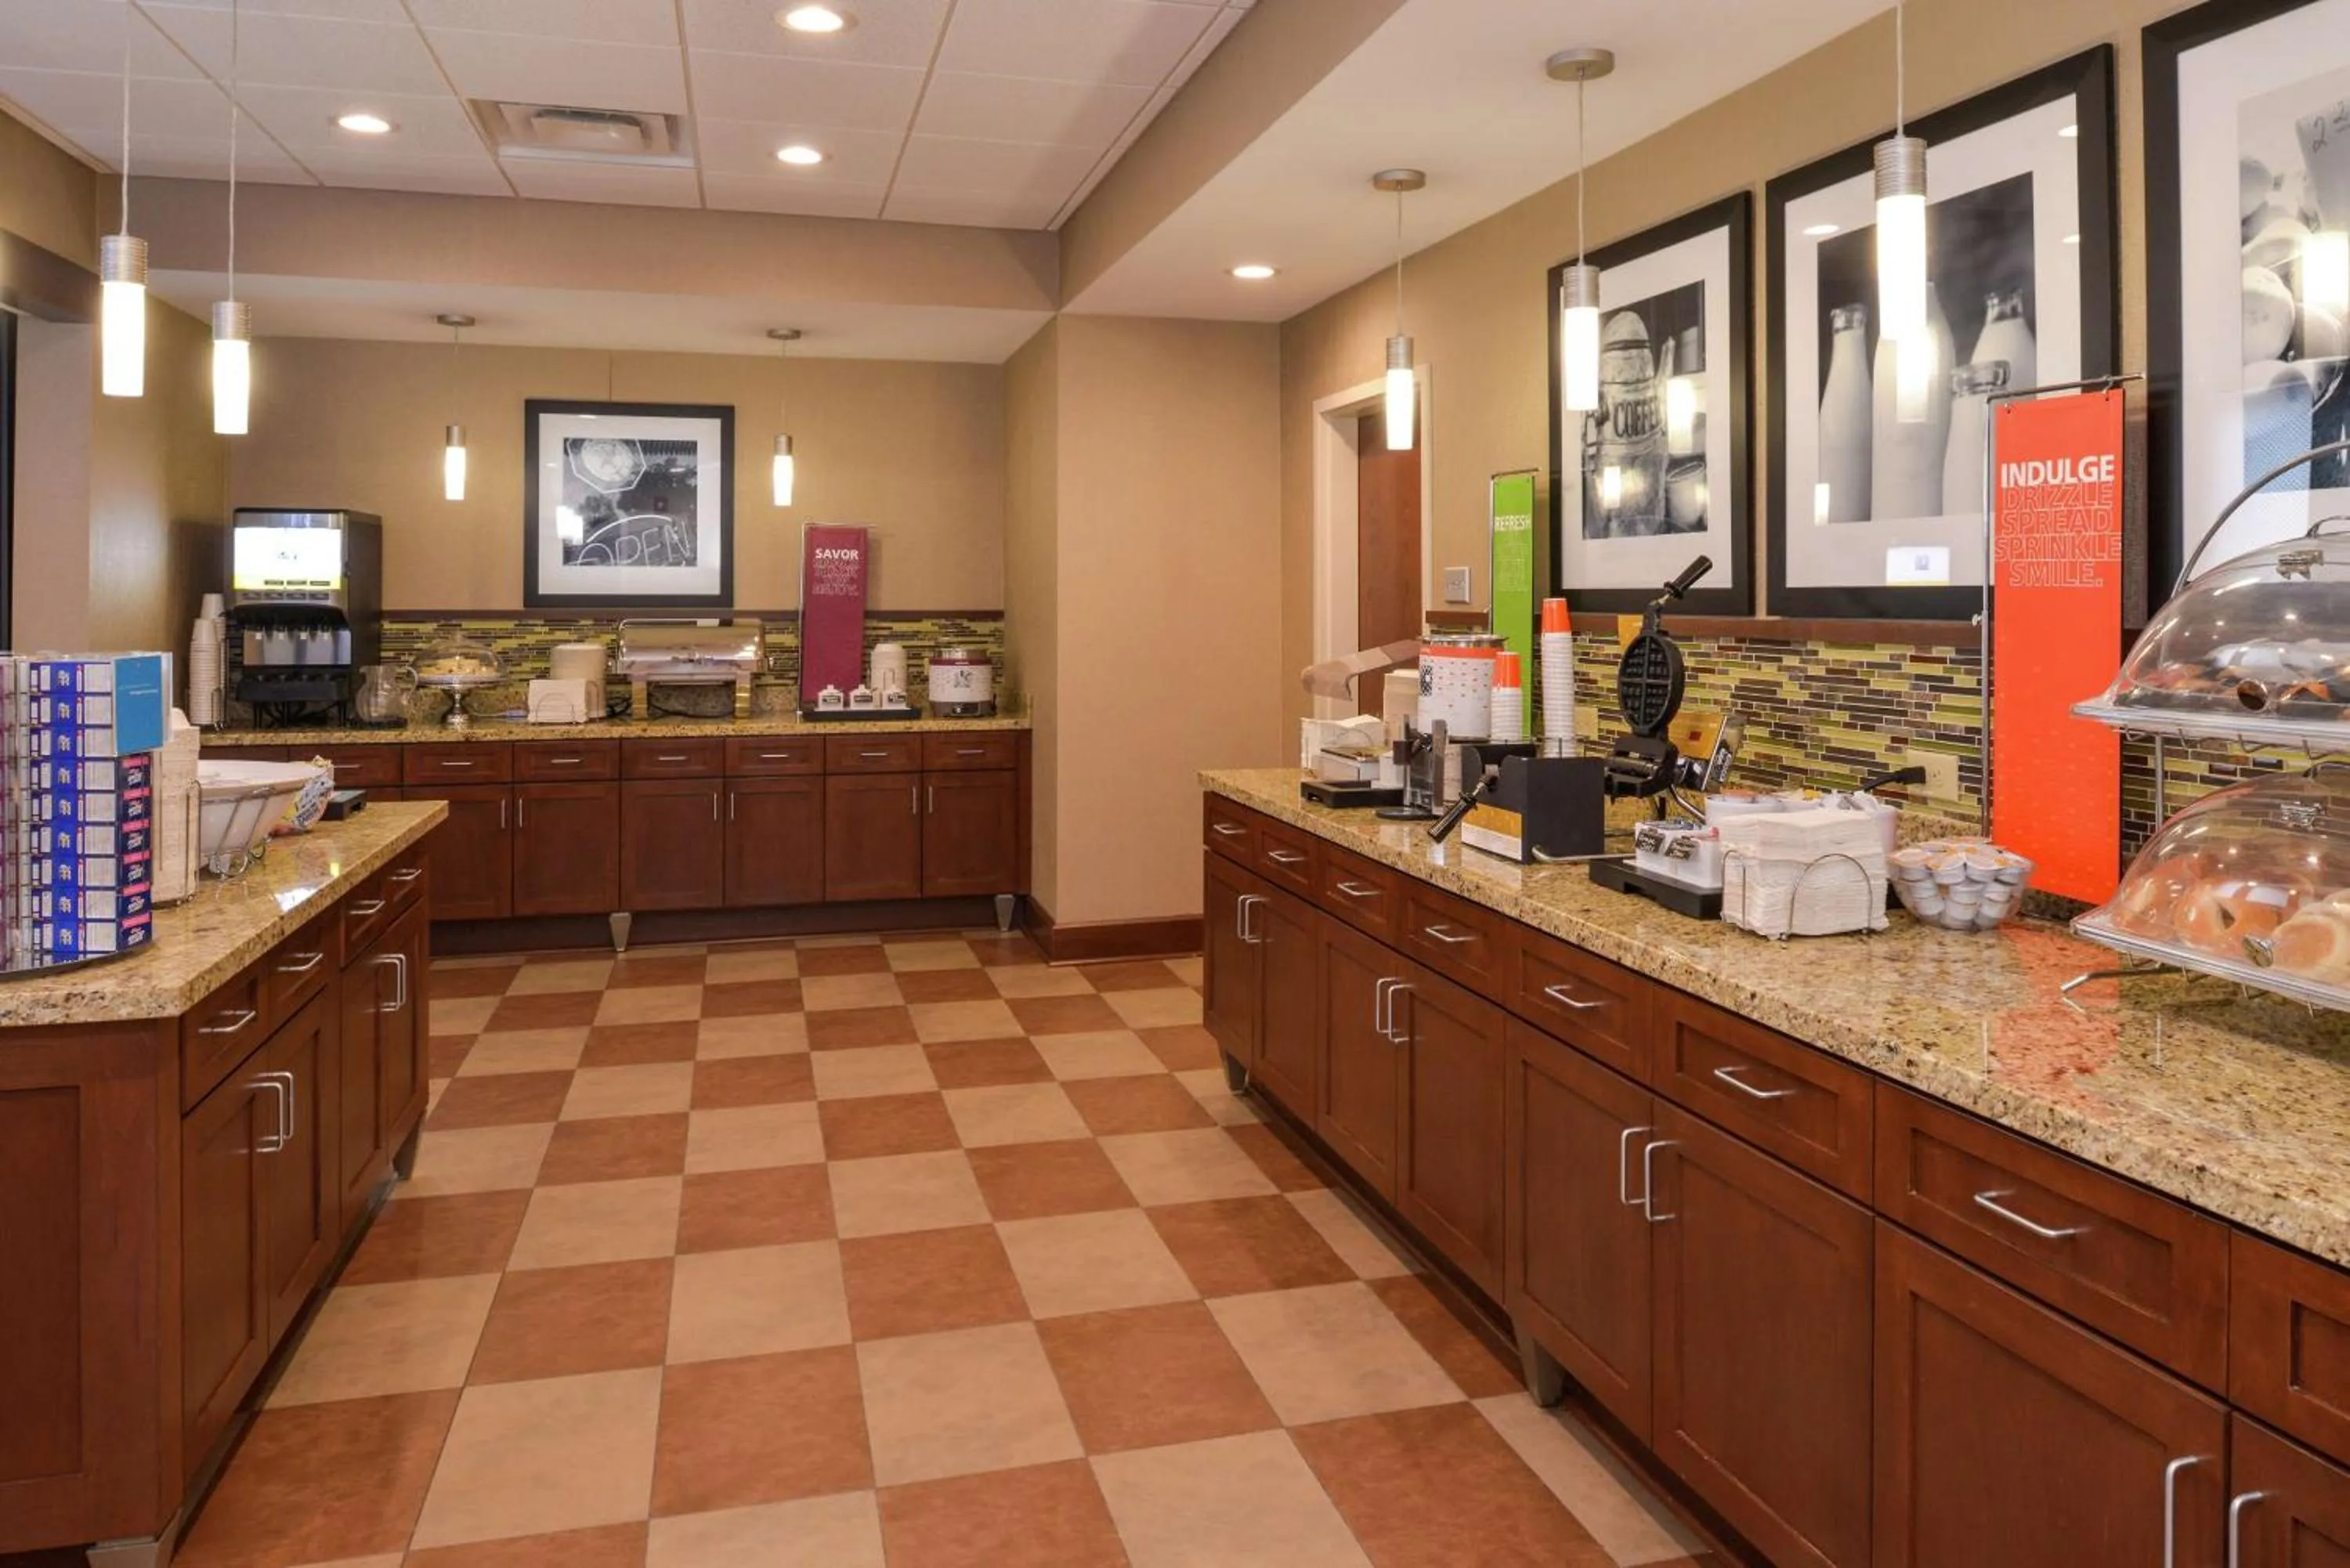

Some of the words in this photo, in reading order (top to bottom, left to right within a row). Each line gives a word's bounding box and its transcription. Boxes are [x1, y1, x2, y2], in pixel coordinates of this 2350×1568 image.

[2001, 454, 2114, 488] INDULGE
[2003, 481, 2113, 510] DRIZZLE
[1495, 515, 1531, 532] REFRESH
[2001, 508, 2113, 537] SPREAD
[815, 547, 859, 561] SAVOR
[1994, 533, 2121, 562] SPRINKLE
[2009, 561, 2104, 587] SMILE.
